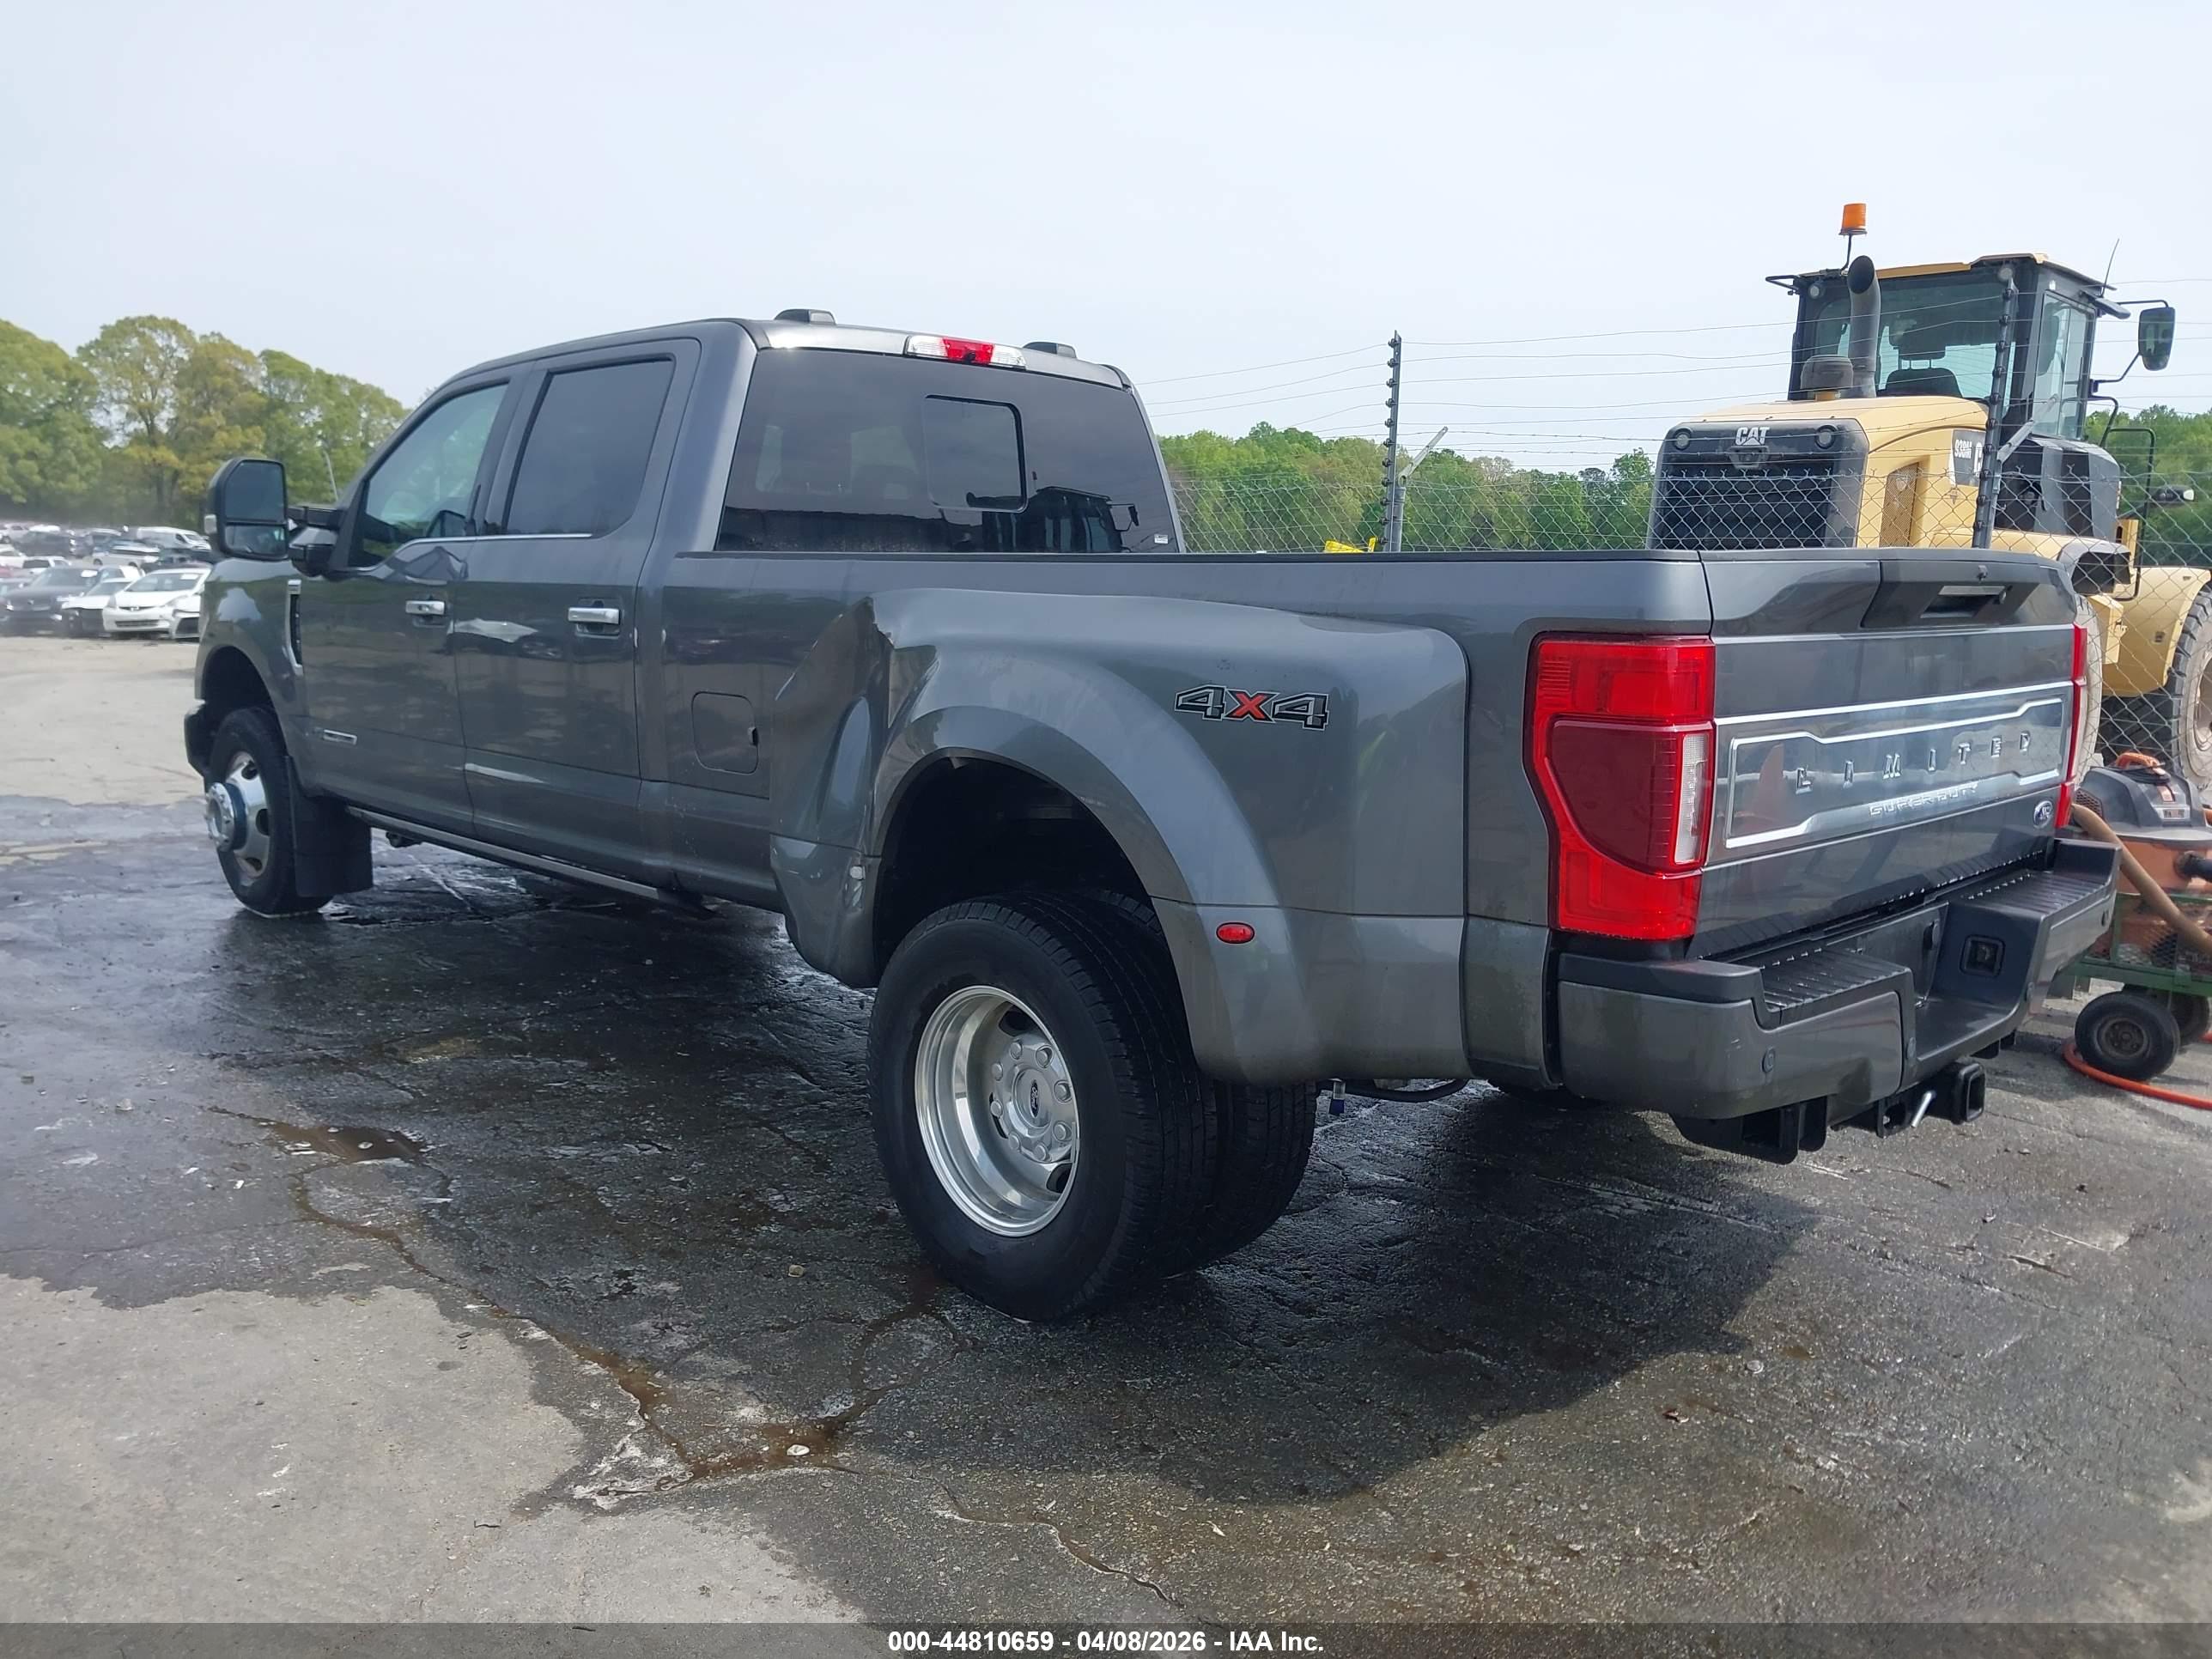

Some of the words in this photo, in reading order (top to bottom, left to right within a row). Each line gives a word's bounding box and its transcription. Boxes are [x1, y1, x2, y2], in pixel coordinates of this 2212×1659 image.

[1735, 427, 1770, 445] CAT
[1796, 730, 2031, 795] LIMITED
[1869, 795, 1934, 816] SUPER
[1936, 781, 1979, 802] DUTY
